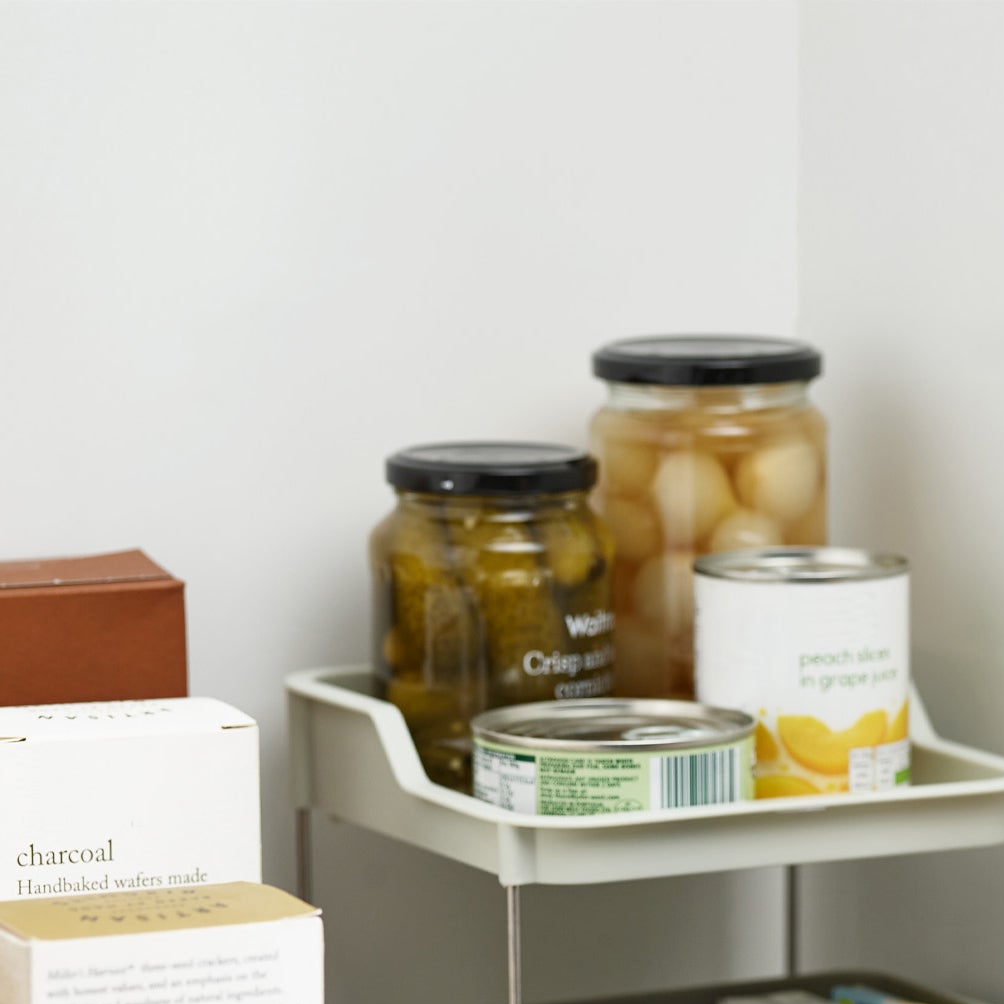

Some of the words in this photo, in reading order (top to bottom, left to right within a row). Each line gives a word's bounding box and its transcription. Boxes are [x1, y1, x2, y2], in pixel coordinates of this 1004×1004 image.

[523, 650, 581, 677] Crisp
[799, 651, 852, 668] peach
[801, 675, 815, 687] in
[818, 672, 867, 693] grape
[16, 839, 114, 867] charcoal
[17, 874, 109, 896] Handbaked
[114, 871, 163, 889] wafers
[168, 867, 208, 885] made
